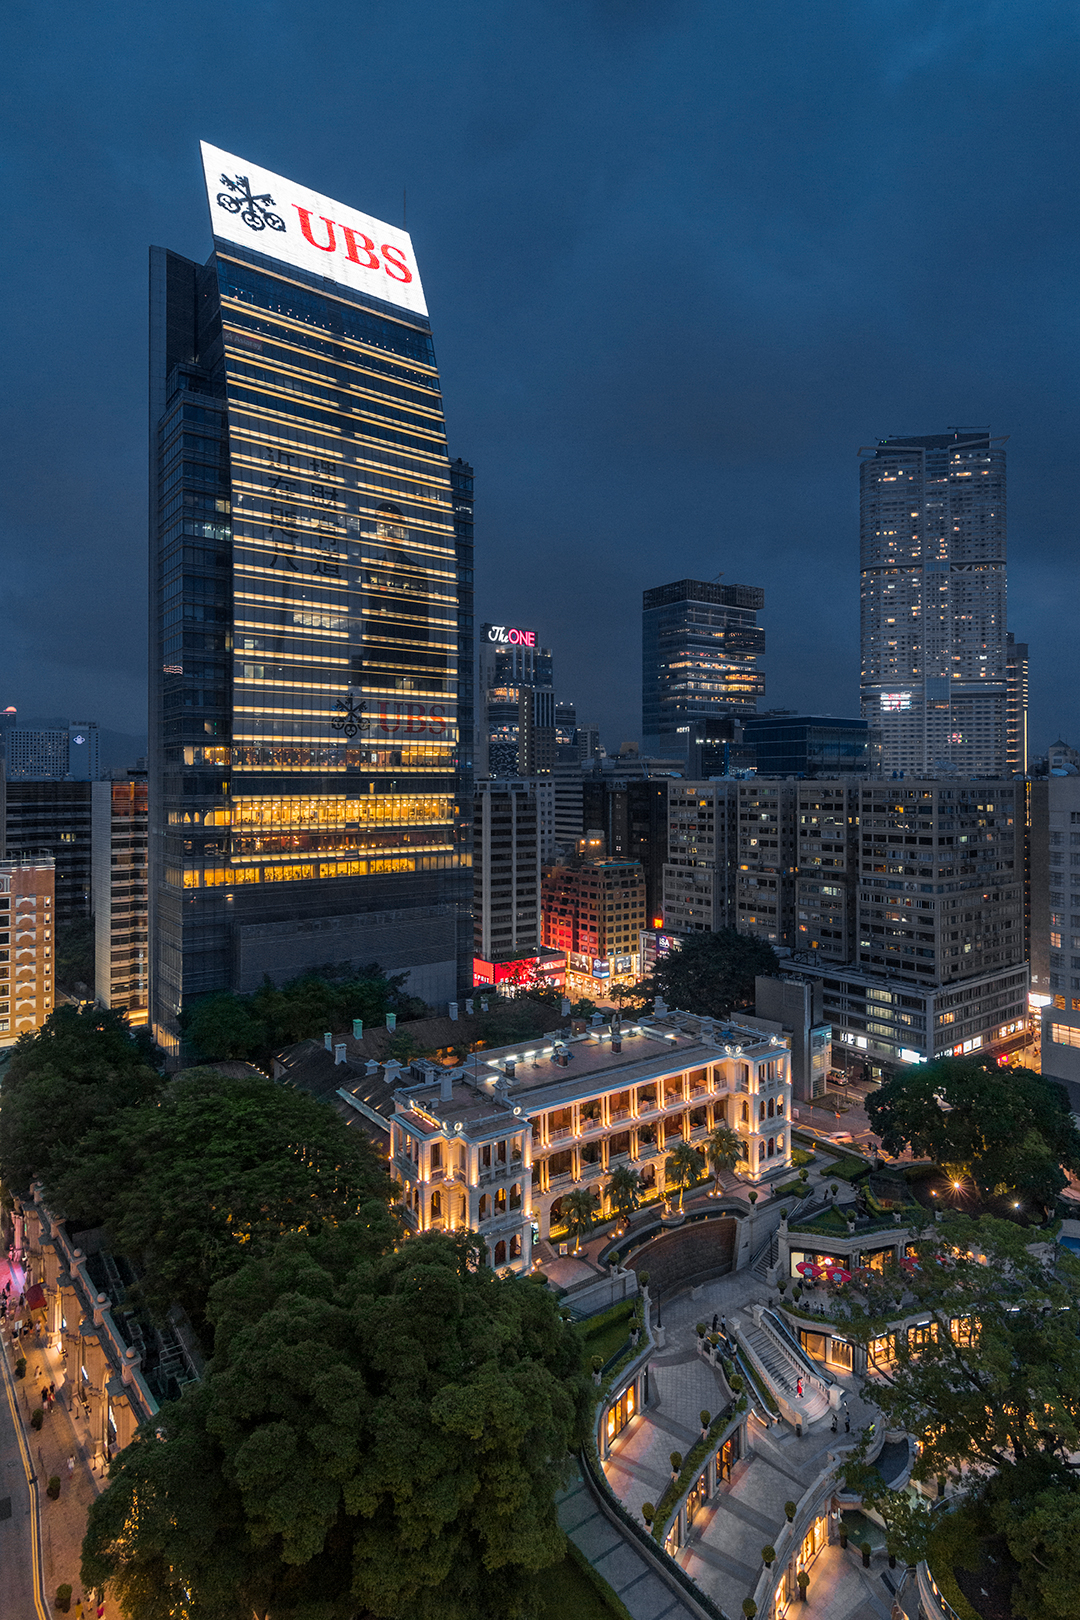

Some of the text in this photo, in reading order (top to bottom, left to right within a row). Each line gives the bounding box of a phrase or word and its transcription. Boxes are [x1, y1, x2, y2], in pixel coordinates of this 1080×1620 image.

[291, 203, 413, 284] UBS
[488, 625, 536, 648] The ONE
[377, 701, 448, 735] UBS
